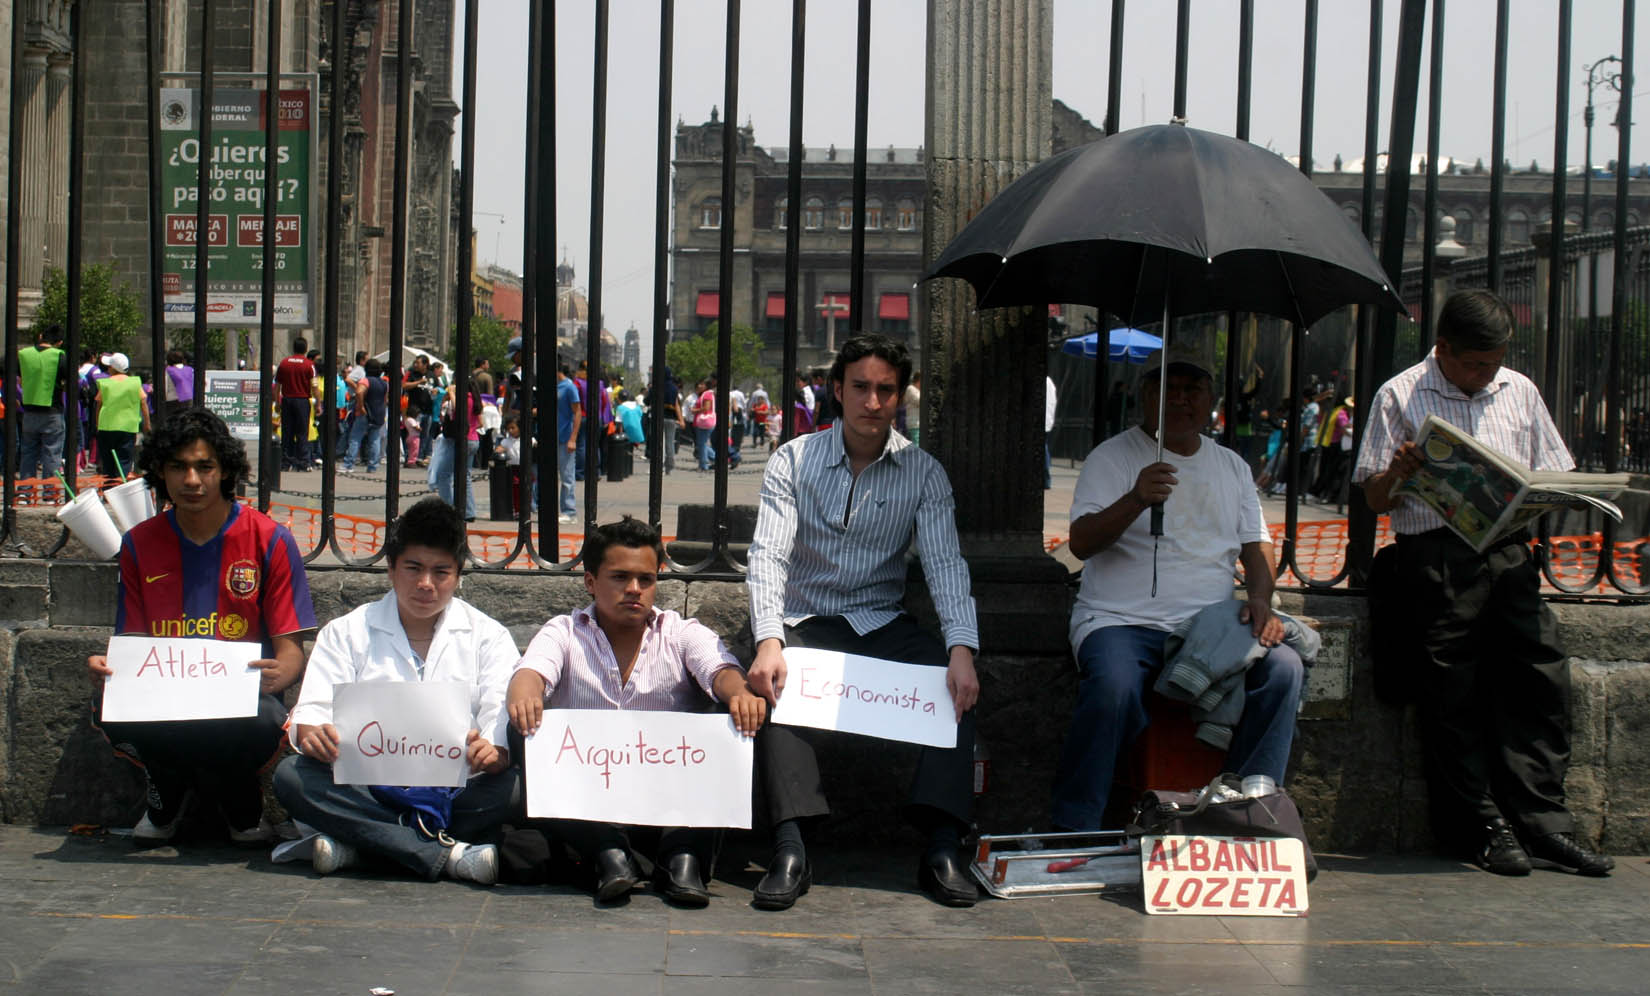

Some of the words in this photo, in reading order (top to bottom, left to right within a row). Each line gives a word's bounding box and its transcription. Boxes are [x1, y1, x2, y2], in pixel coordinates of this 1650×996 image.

[279, 100, 304, 108] XICO
[244, 169, 265, 185] qu
[174, 180, 227, 208] paó
[234, 178, 299, 209] aqí?
[240, 220, 297, 231] MENAJE
[255, 231, 282, 242] SS
[152, 612, 218, 637] unicef
[136, 645, 227, 679] Atleta
[800, 667, 936, 716] Economista
[357, 720, 462, 760] Químico
[555, 724, 706, 790] Arquitecto
[1151, 877, 1297, 909] LOZETA
